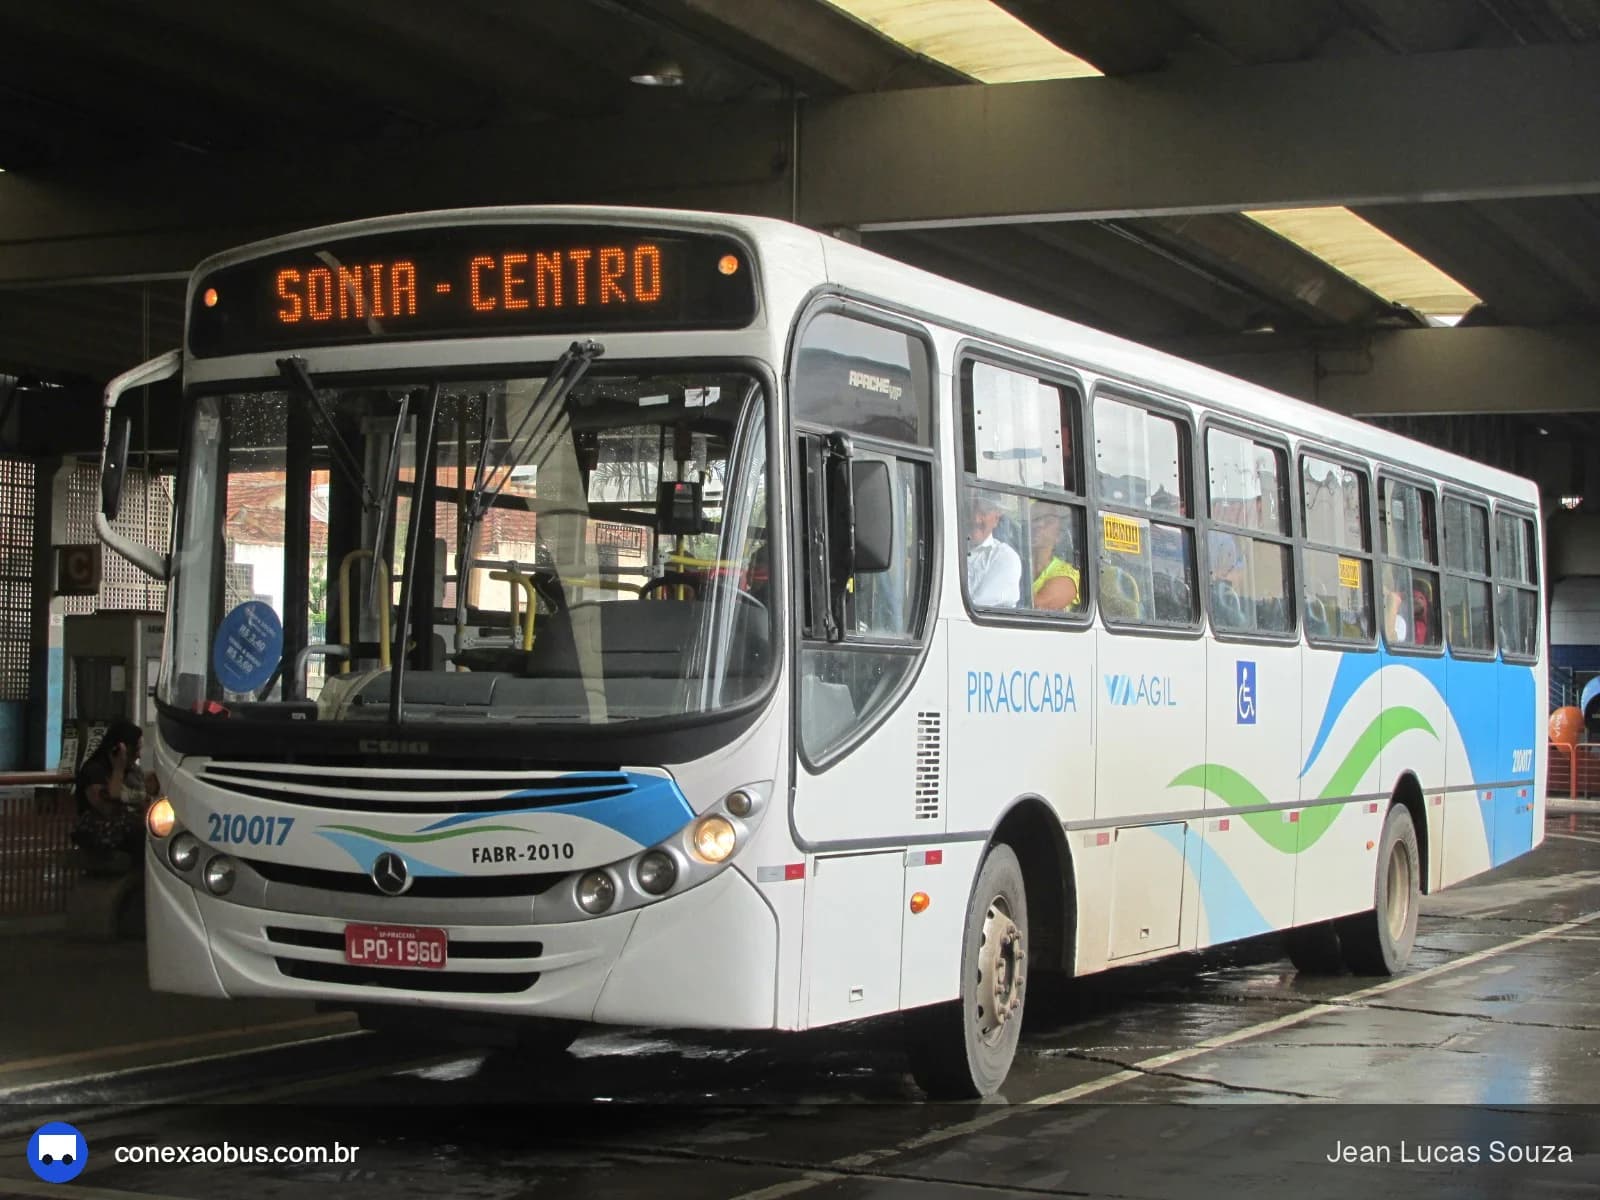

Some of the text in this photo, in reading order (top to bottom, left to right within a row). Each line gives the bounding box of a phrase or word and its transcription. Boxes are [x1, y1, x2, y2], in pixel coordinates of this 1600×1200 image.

[276, 261, 417, 323] SONIA
[470, 245, 662, 312] CENTRO
[849, 369, 890, 394] APACHE
[70, 555, 88, 579] C
[967, 670, 1076, 712] PIRACICABA
[208, 812, 295, 846] 210017
[472, 843, 574, 864] FABR-2010
